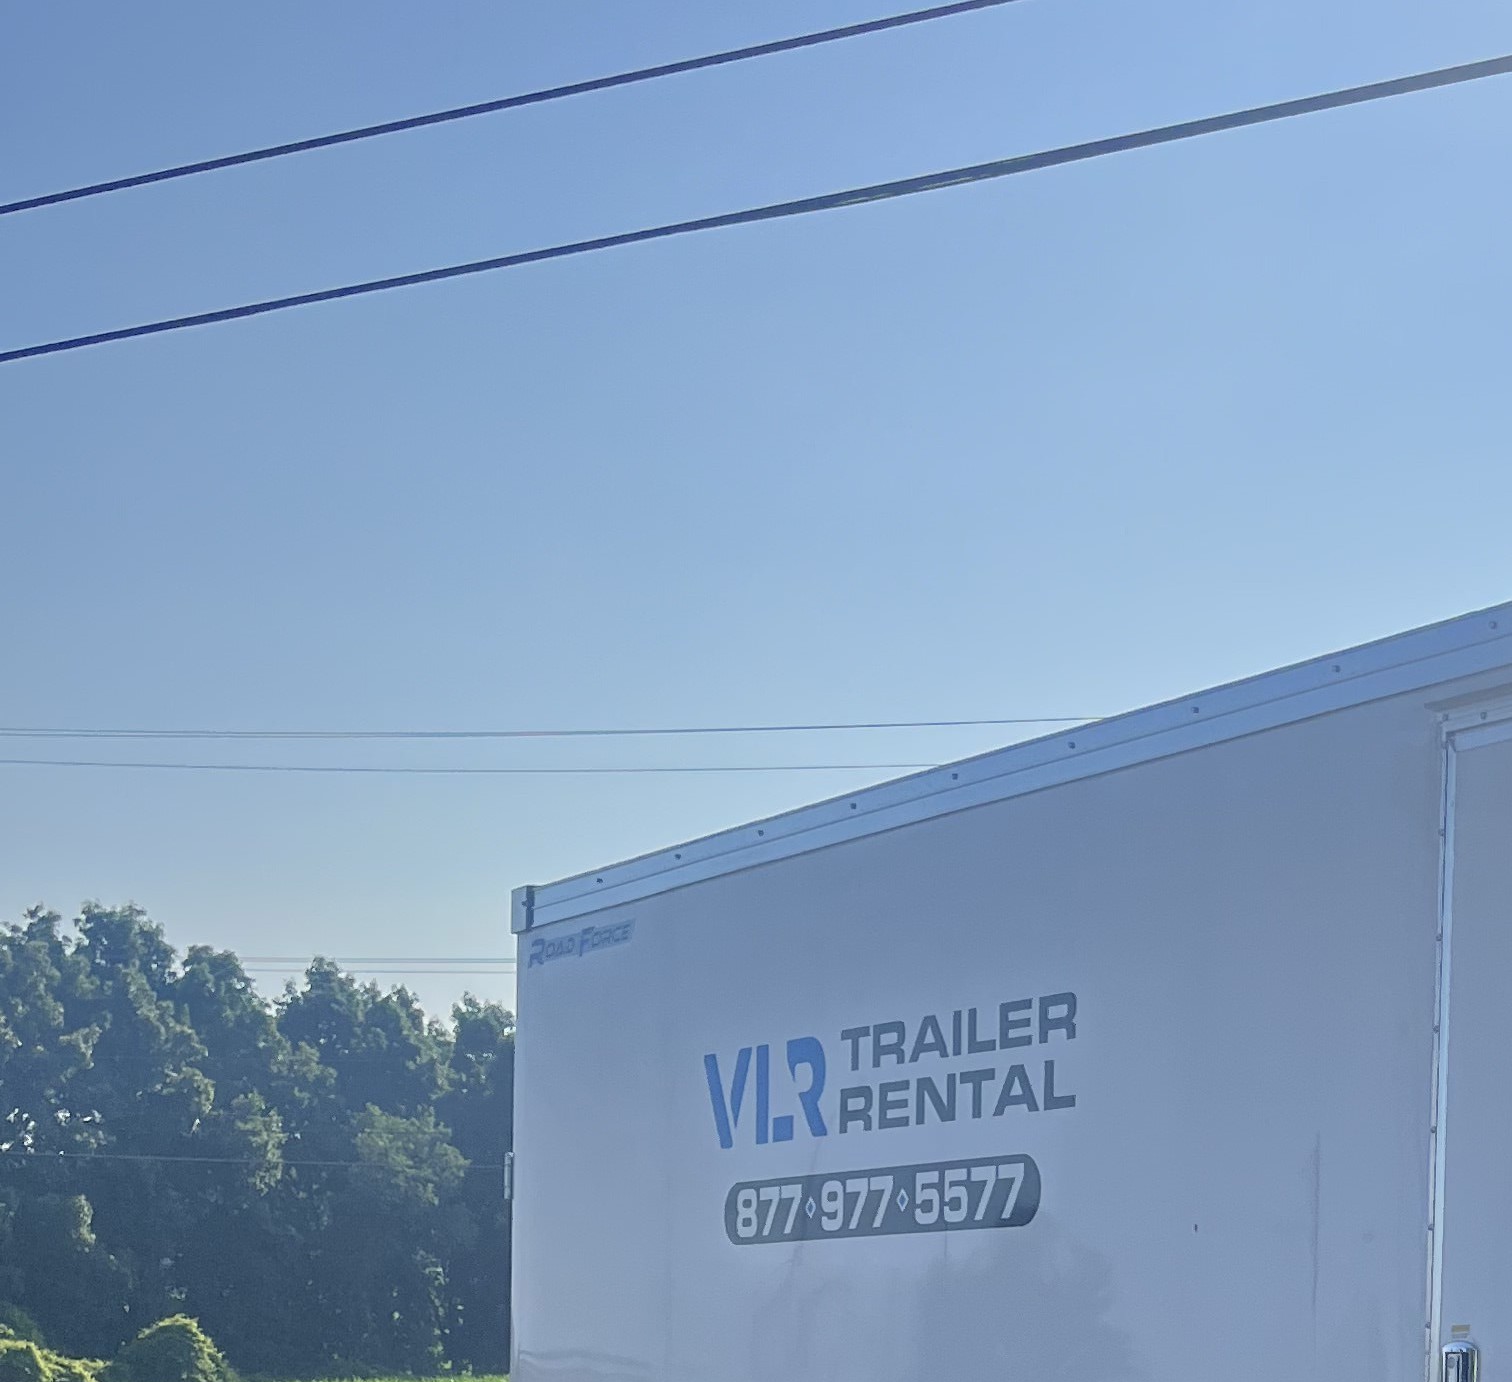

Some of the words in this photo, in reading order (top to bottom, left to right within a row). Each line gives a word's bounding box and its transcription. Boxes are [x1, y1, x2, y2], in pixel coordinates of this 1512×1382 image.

[840, 991, 1078, 1072] TRAILER
[703, 1036, 828, 1150] VLR
[838, 1059, 1077, 1135] RENTAL
